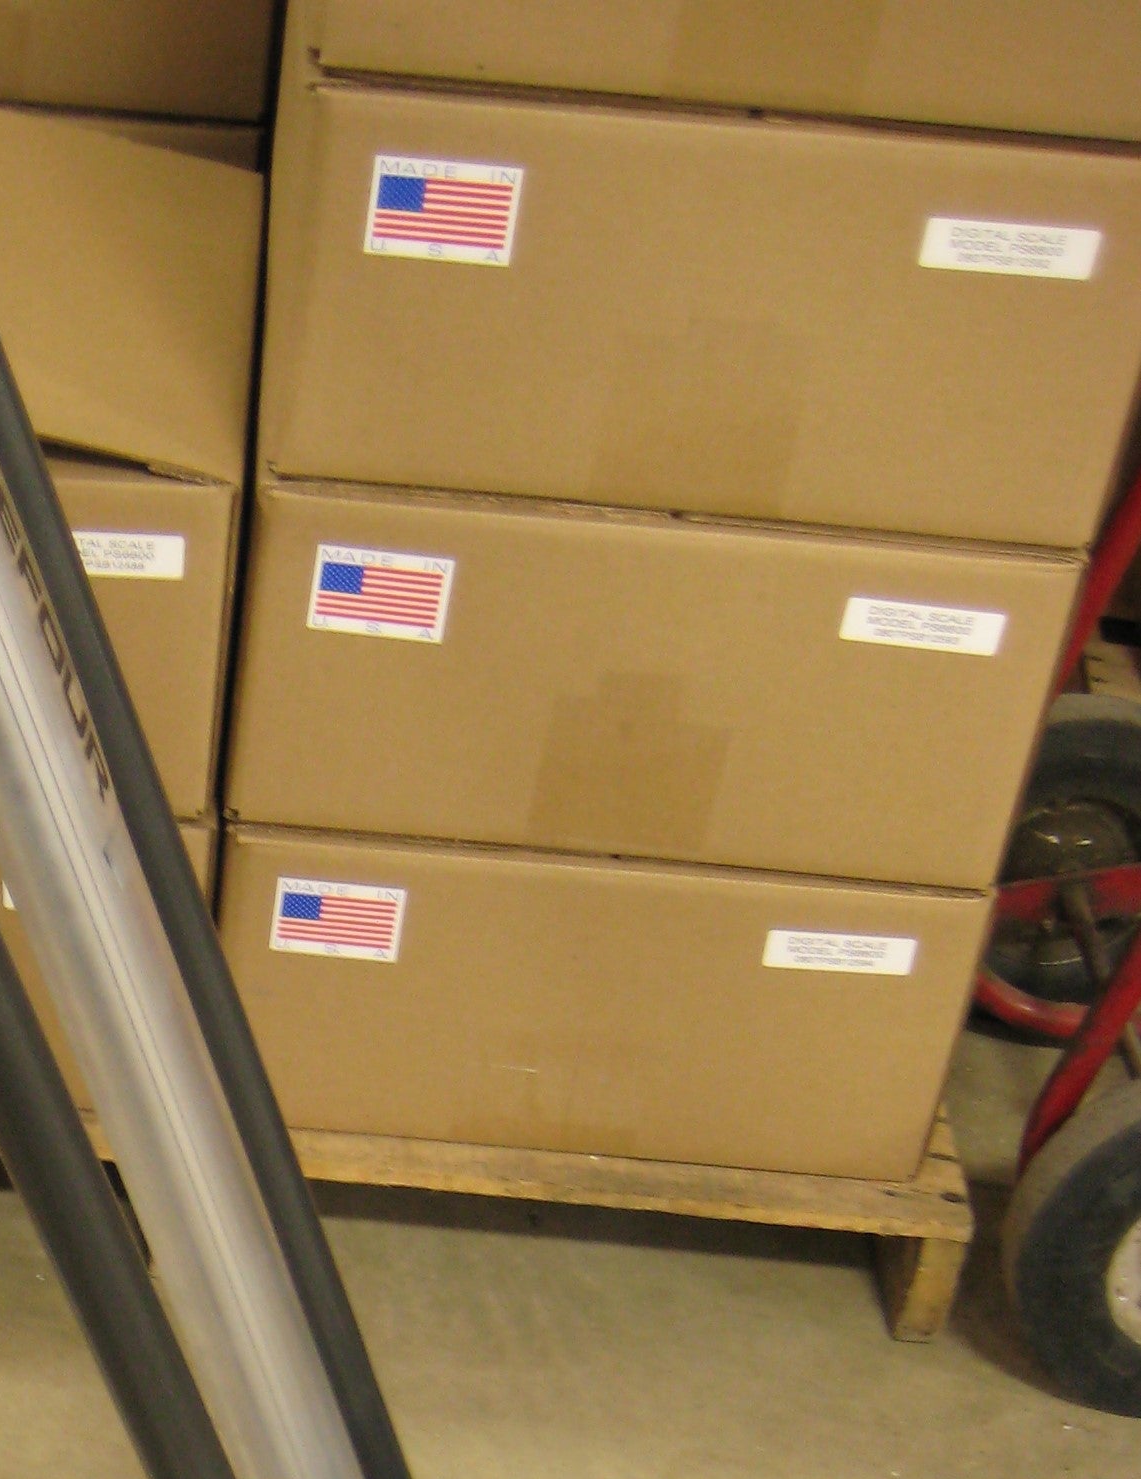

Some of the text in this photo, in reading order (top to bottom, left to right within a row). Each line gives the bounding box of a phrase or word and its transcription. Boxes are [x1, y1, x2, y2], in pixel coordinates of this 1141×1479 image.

[380, 159, 518, 185] MADE IN
[108, 540, 154, 550] SCALE
[321, 548, 449, 573] MADE IN
[282, 880, 401, 902] MADE IN
